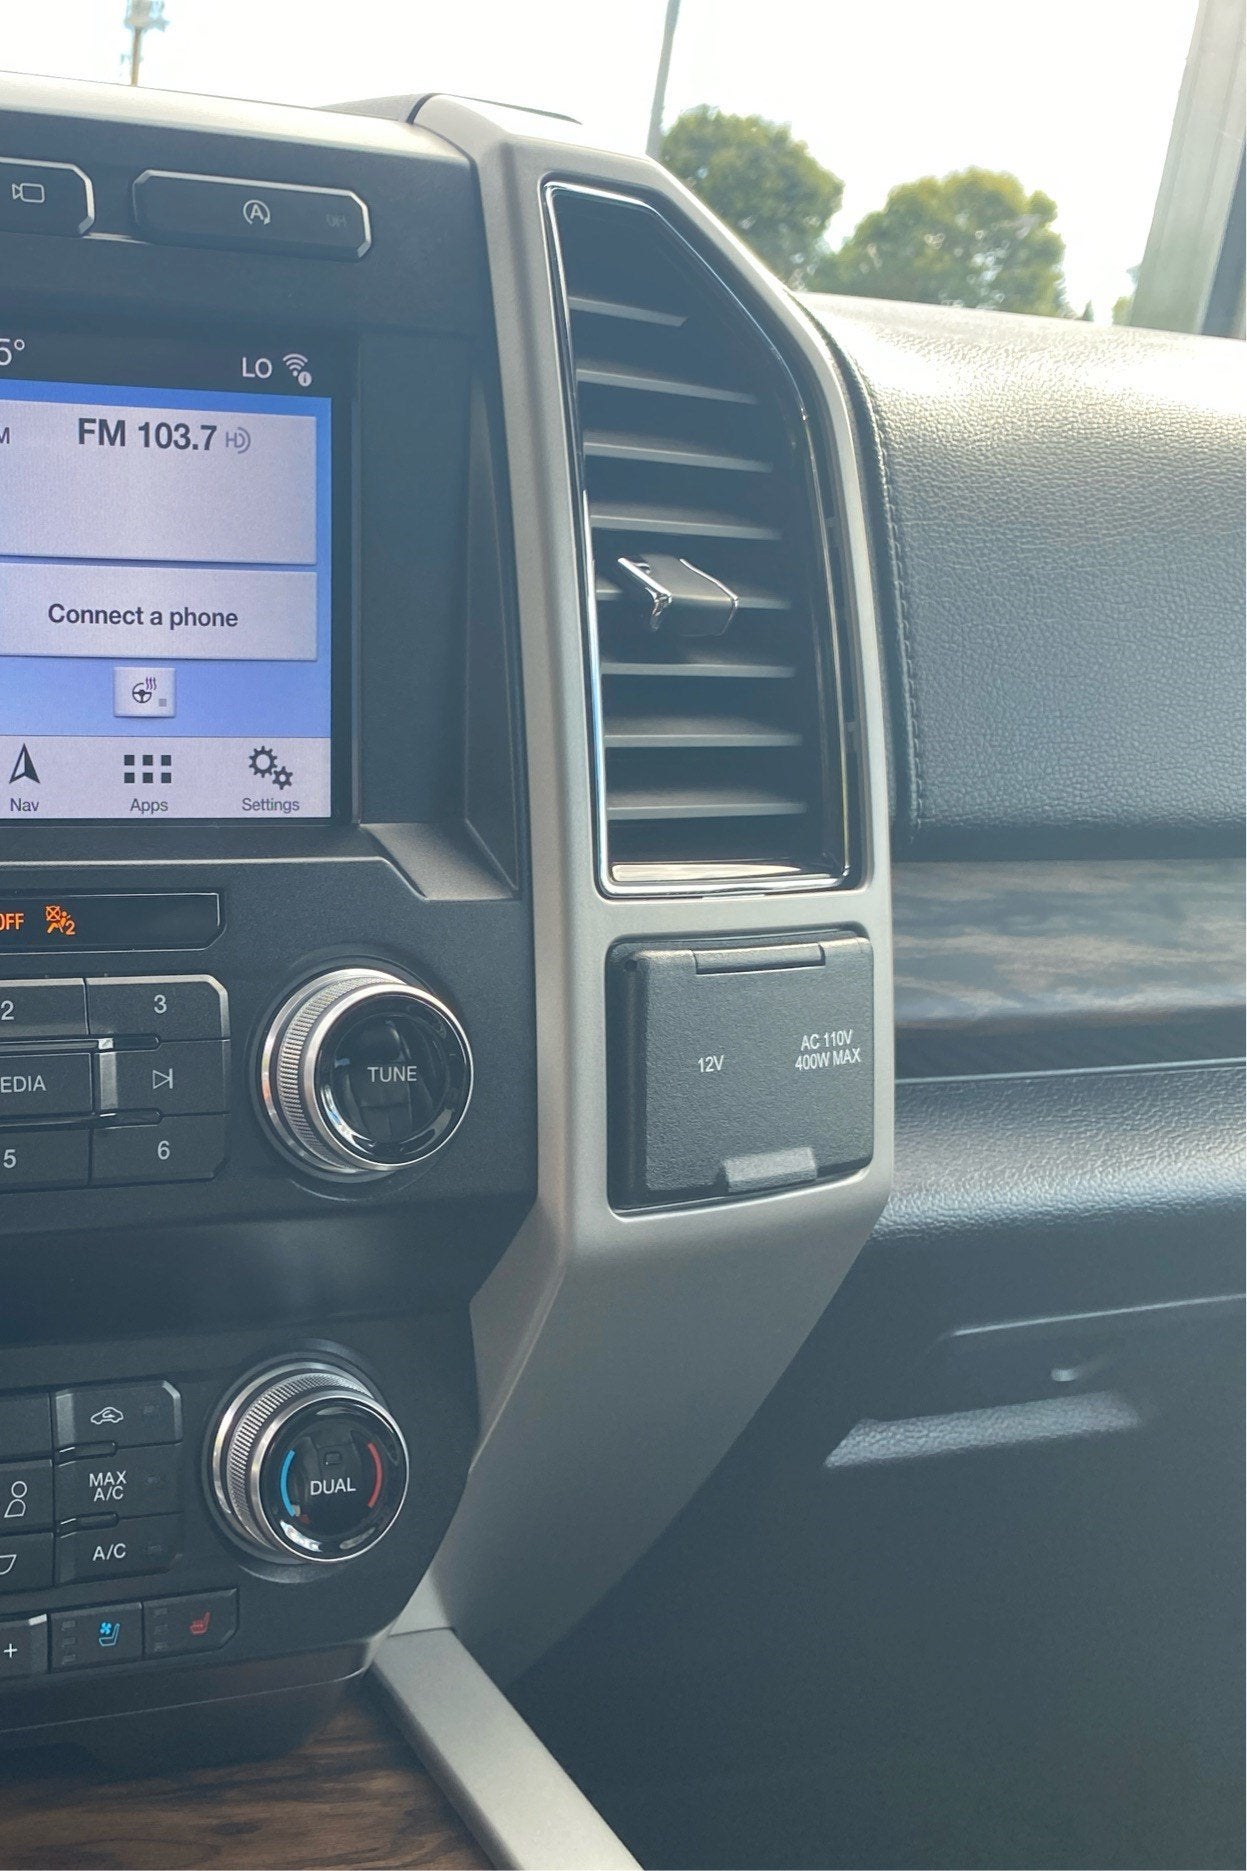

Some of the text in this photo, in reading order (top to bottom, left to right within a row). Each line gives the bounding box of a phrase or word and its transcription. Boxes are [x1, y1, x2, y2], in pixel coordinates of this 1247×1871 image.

[241, 356, 273, 379] LO
[78, 417, 127, 447] FM
[137, 421, 218, 452] 103.7
[48, 602, 239, 631] Connect a phone
[9, 797, 40, 813] Nav
[129, 797, 169, 816] Apps
[241, 797, 300, 816] Settings
[0, 1000, 15, 1021] 2
[153, 994, 168, 1014] 3
[800, 1029, 853, 1052] AC 110V
[697, 1054, 725, 1073] 12V
[794, 1047, 861, 1071] 400W MAX
[366, 1065, 418, 1084] TUNE
[2, 1149, 17, 1169] 5
[157, 1140, 171, 1160] 6
[89, 1470, 128, 1487] MAX
[310, 1477, 357, 1496] DUAL
[92, 1485, 124, 1502] A/C
[92, 1543, 127, 1561] A/C
